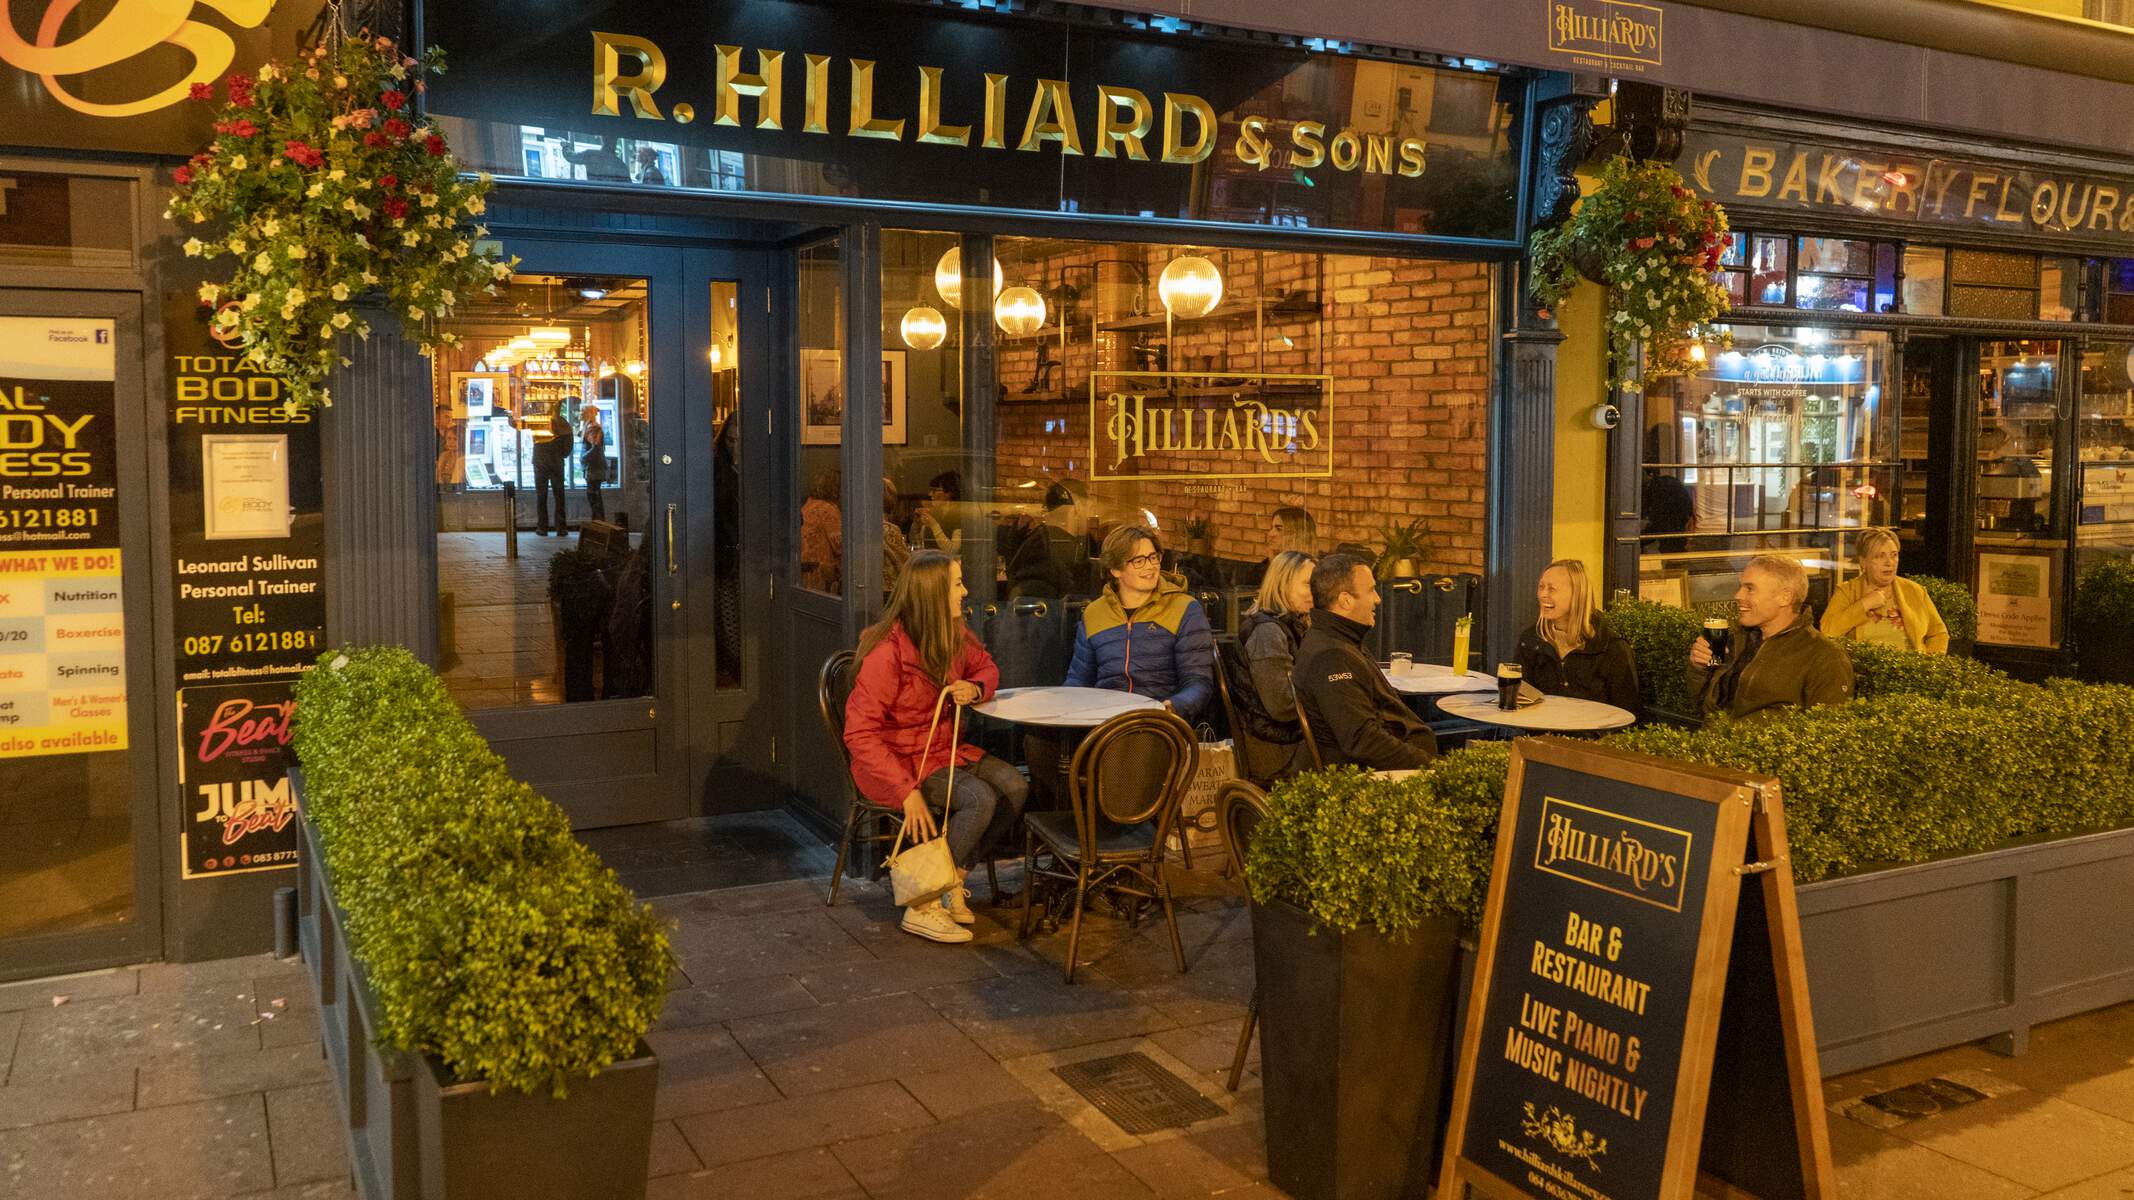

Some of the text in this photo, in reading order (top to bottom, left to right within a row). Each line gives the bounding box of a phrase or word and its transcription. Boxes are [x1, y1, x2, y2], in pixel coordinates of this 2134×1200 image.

[1555, 4, 1656, 53] HILLIARD'S
[713, 44, 1218, 164] HILLIARD
[1235, 115, 1273, 172] &
[1290, 120, 1426, 178] SONS
[1736, 145, 1960, 215] BAKERY
[1963, 171, 2119, 231] FLOUR
[1763, 389, 1780, 397] WITH
[1782, 389, 1808, 397] COFFEE
[176, 407, 311, 424] FITNESS
[1107, 392, 1319, 471] HILLIARD'S
[3, 483, 115, 500] Personal Trainer
[54, 556, 79, 571] WE
[84, 555, 115, 570] DO!
[178, 554, 317, 574] Leonard Sullivan
[54, 590, 118, 602] Nutrition
[180, 579, 317, 599] Personal Trainer
[232, 603, 265, 624] Tel:
[1697, 601, 1738, 612] WHISKE
[56, 627, 121, 639] Boxercise
[184, 635, 224, 656] 087
[57, 664, 119, 678] Spinning
[183, 669, 211, 680] email:
[70, 707, 113, 718] Classes
[0, 730, 118, 751] also available
[1200, 766, 1225, 778] ARAN
[197, 777, 298, 823] JUM
[1544, 813, 1677, 891] HILLIARD'S
[1565, 911, 1623, 962] BAR &
[1531, 940, 1651, 1016] RESTAURANT
[1520, 992, 1641, 1073] LIVE PIANO &
[1504, 1026, 1648, 1121] MUSIC NIGHTLY
